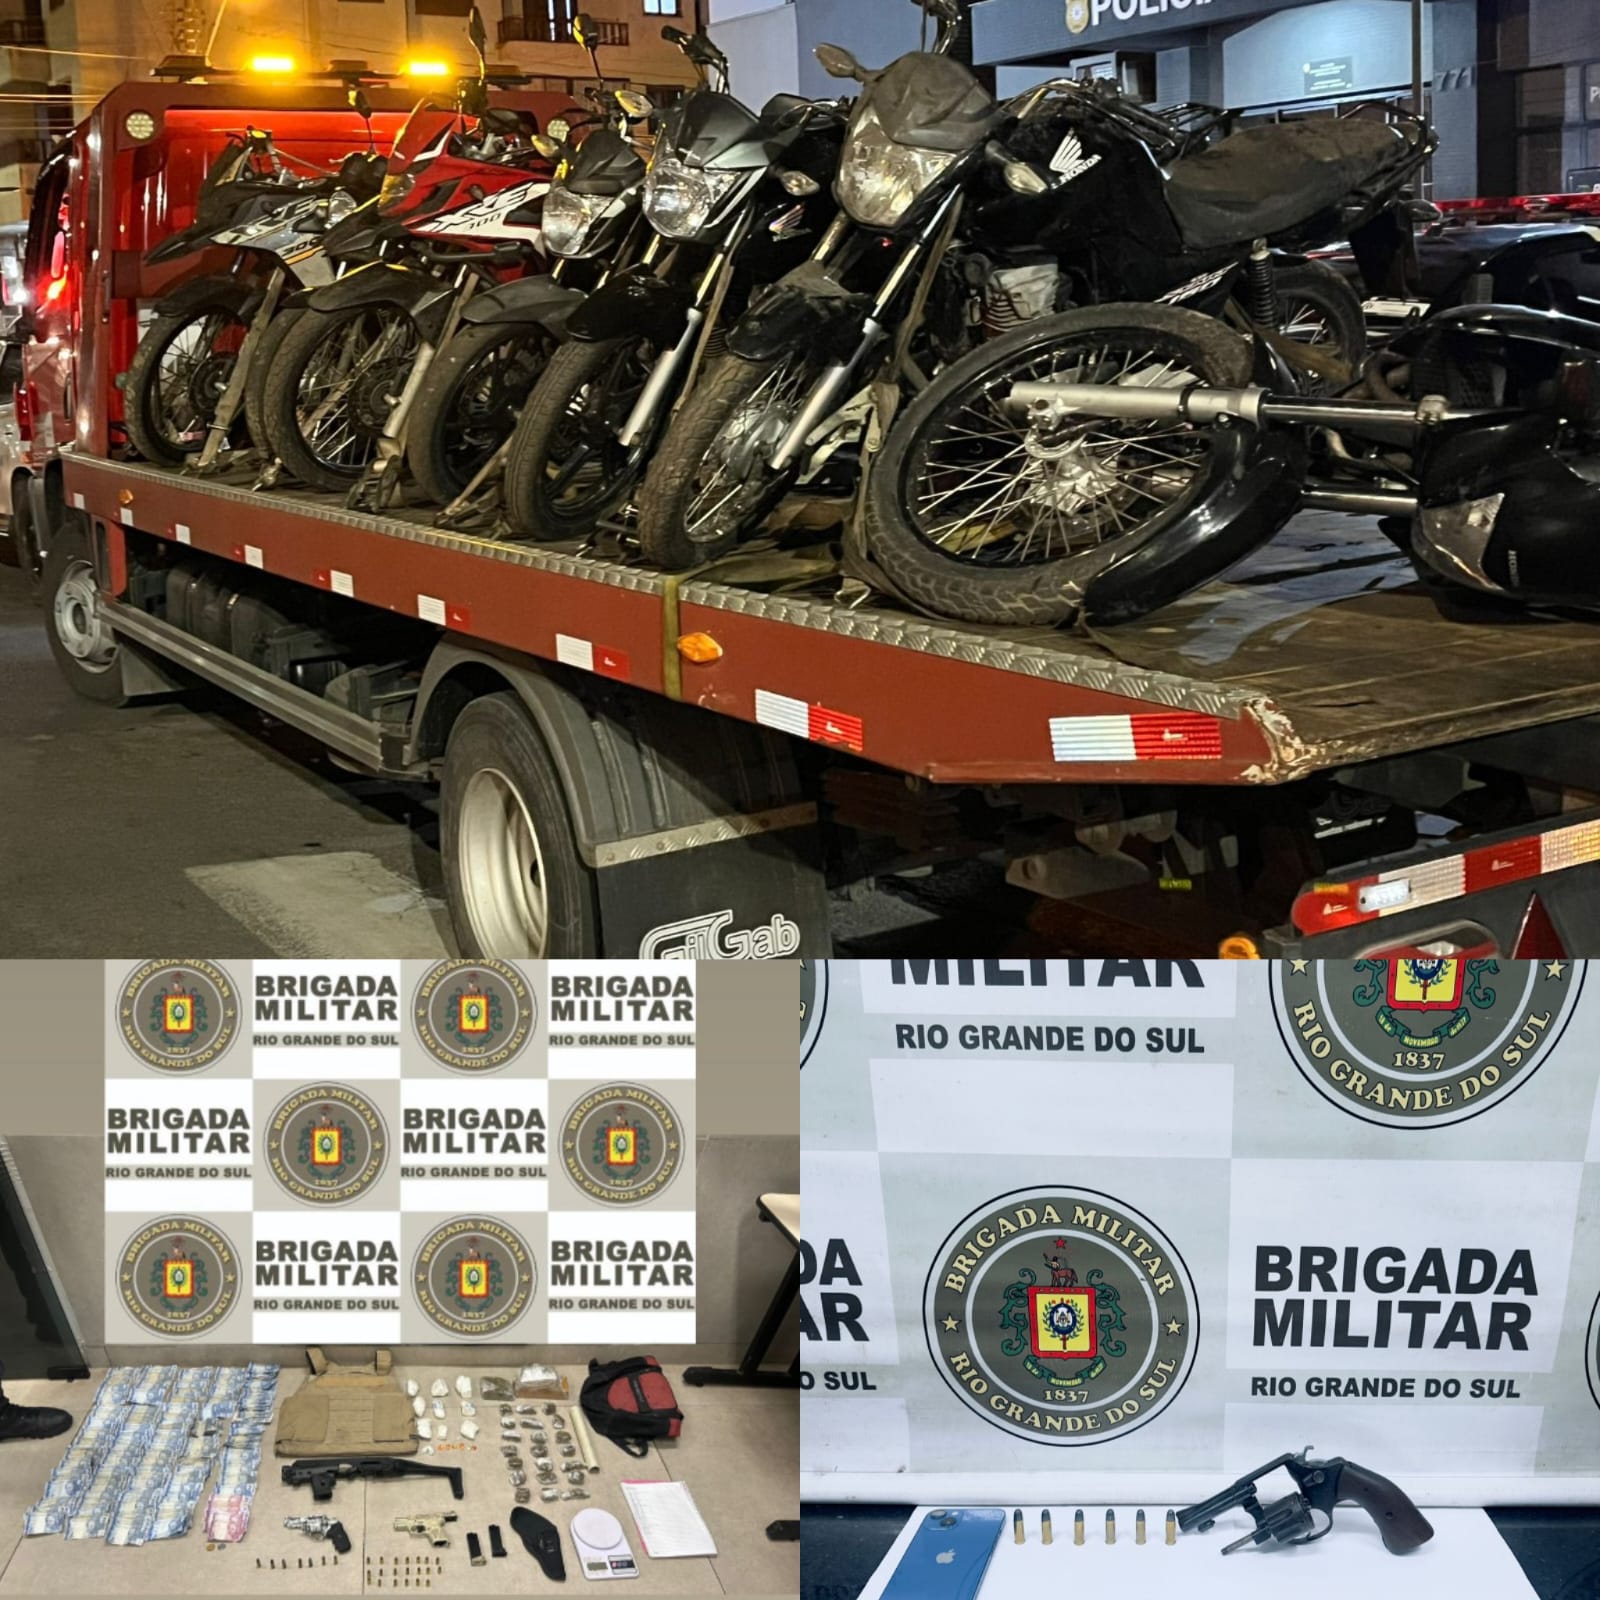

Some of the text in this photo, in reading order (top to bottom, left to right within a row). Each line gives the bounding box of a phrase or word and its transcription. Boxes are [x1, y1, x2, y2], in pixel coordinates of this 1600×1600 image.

[1058, 154, 1102, 186] HONDA
[890, 960, 1205, 988] MILITAR
[256, 976, 397, 996] BRIGADA
[552, 976, 693, 997] BRIGADA
[256, 1000, 397, 1020] MILITAR
[552, 1001, 693, 1020] MILITAR
[253, 1035, 398, 1045] RIO GRANDE DO SUL
[550, 1035, 694, 1045] RIO GRANDE DO SUL
[895, 1023, 1205, 1053] RIO GRANDE DO SUL
[197, 1049, 214, 1063] DO
[492, 1049, 509, 1063] DO
[1293, 1000, 1551, 1111] RIO GRANDE DO SUL
[1393, 1051, 1445, 1070] 1837
[109, 1109, 249, 1129] BRIGADA
[405, 1109, 545, 1129] BRIGADA
[108, 1133, 249, 1153] MILITAR
[404, 1133, 545, 1153] MILITAR
[106, 1168, 251, 1177] RIO GRANDE DO SUL
[401, 1167, 546, 1177] RIO GRANDE DO SUL
[344, 1182, 362, 1196] DO
[639, 1182, 656, 1196] DO
[257, 1241, 397, 1261] BRIGADA
[552, 1241, 693, 1261] BRIGADA
[944, 1204, 1176, 1296] BRIGADA MILITAR
[257, 1265, 397, 1285] MILITAR
[552, 1265, 693, 1285] MILITAR
[1254, 1245, 1539, 1296] BRIGADA
[254, 1300, 399, 1309] RIO GRANDE DO SUL
[549, 1299, 694, 1309] RIO GRANDE DO SUL
[197, 1314, 214, 1328] DO
[492, 1314, 509, 1328] DO
[1252, 1298, 1532, 1352] MILITAR
[823, 1371, 877, 1391] SUL
[1251, 1376, 1521, 1399] RIO GRANDE DO SUL
[950, 1352, 989, 1395] RIO
[990, 1394, 1101, 1433] GRANDE
[1104, 1399, 1140, 1425] DO
[1139, 1357, 1176, 1401] SUL
[1045, 1389, 1089, 1403] 1837
